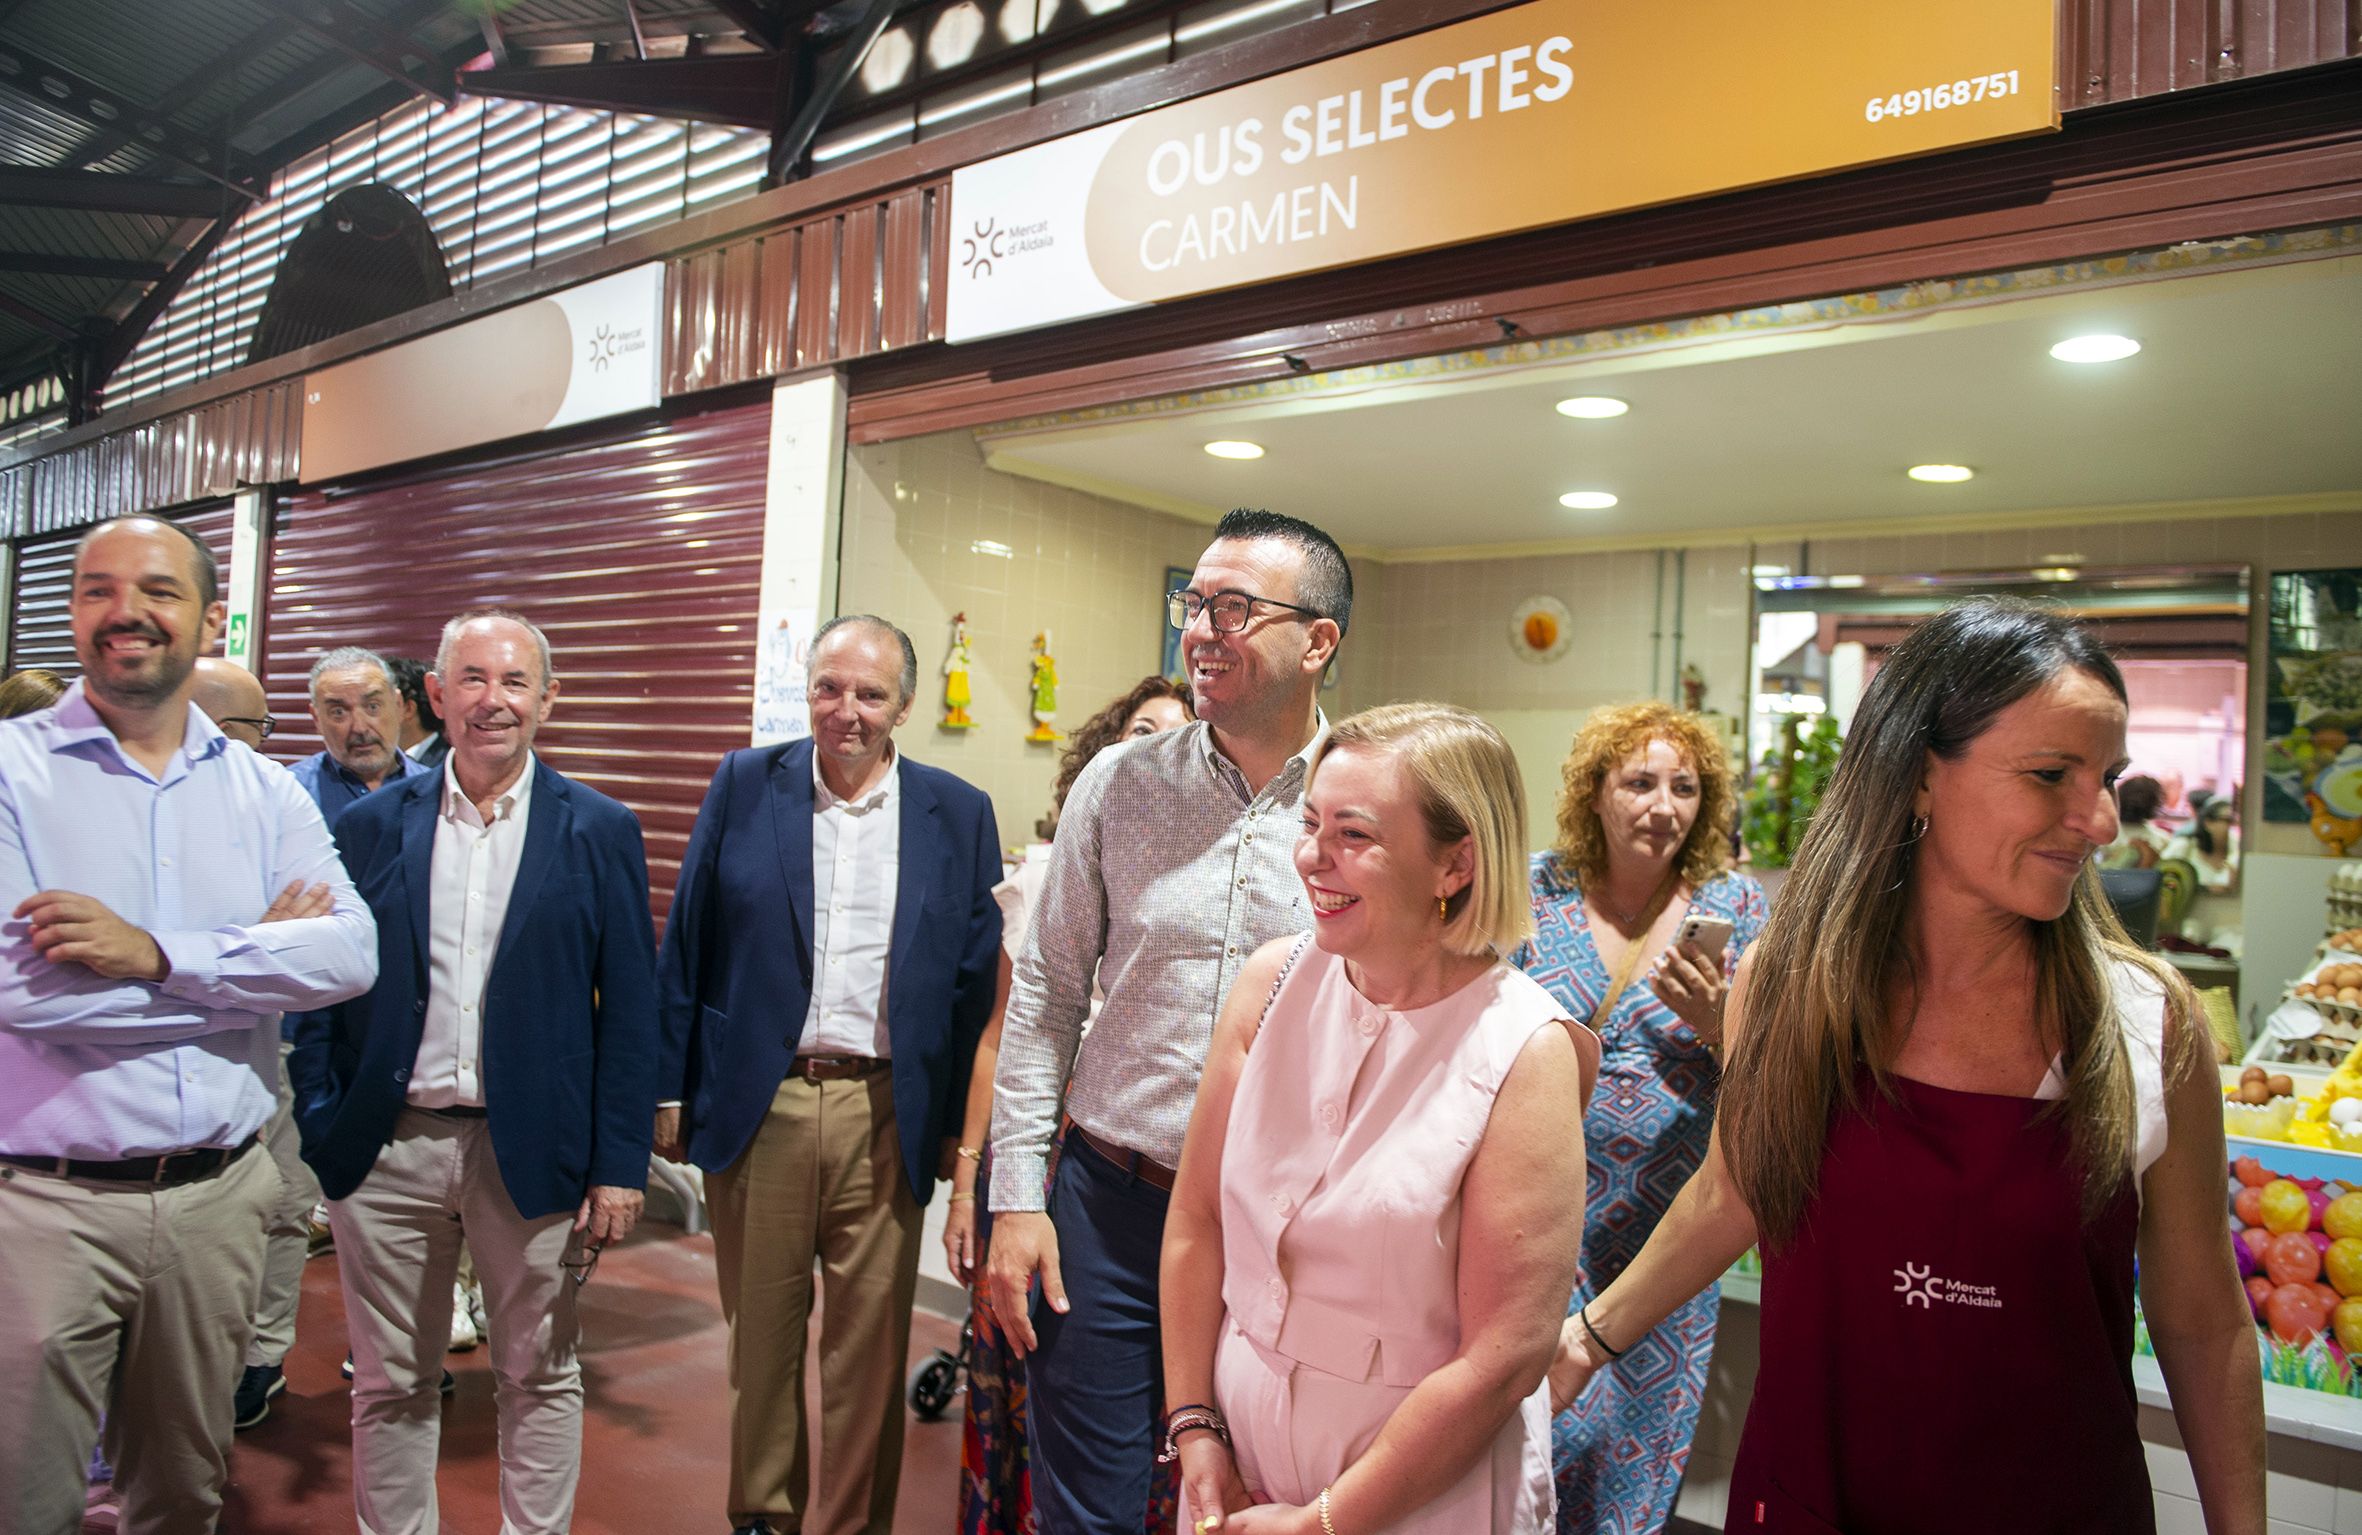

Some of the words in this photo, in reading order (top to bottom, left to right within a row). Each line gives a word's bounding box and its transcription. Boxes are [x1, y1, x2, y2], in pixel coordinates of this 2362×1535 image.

[1864, 69, 2019, 123] 649168751
[1146, 118, 1264, 196] OUS
[1281, 36, 1574, 163] SELECTES
[1009, 219, 1048, 239] Mercat
[1139, 175, 1359, 272] CARMEN
[1945, 1279, 1997, 1296] Mercat
[1945, 1292, 2003, 1308] d'Aldaia
